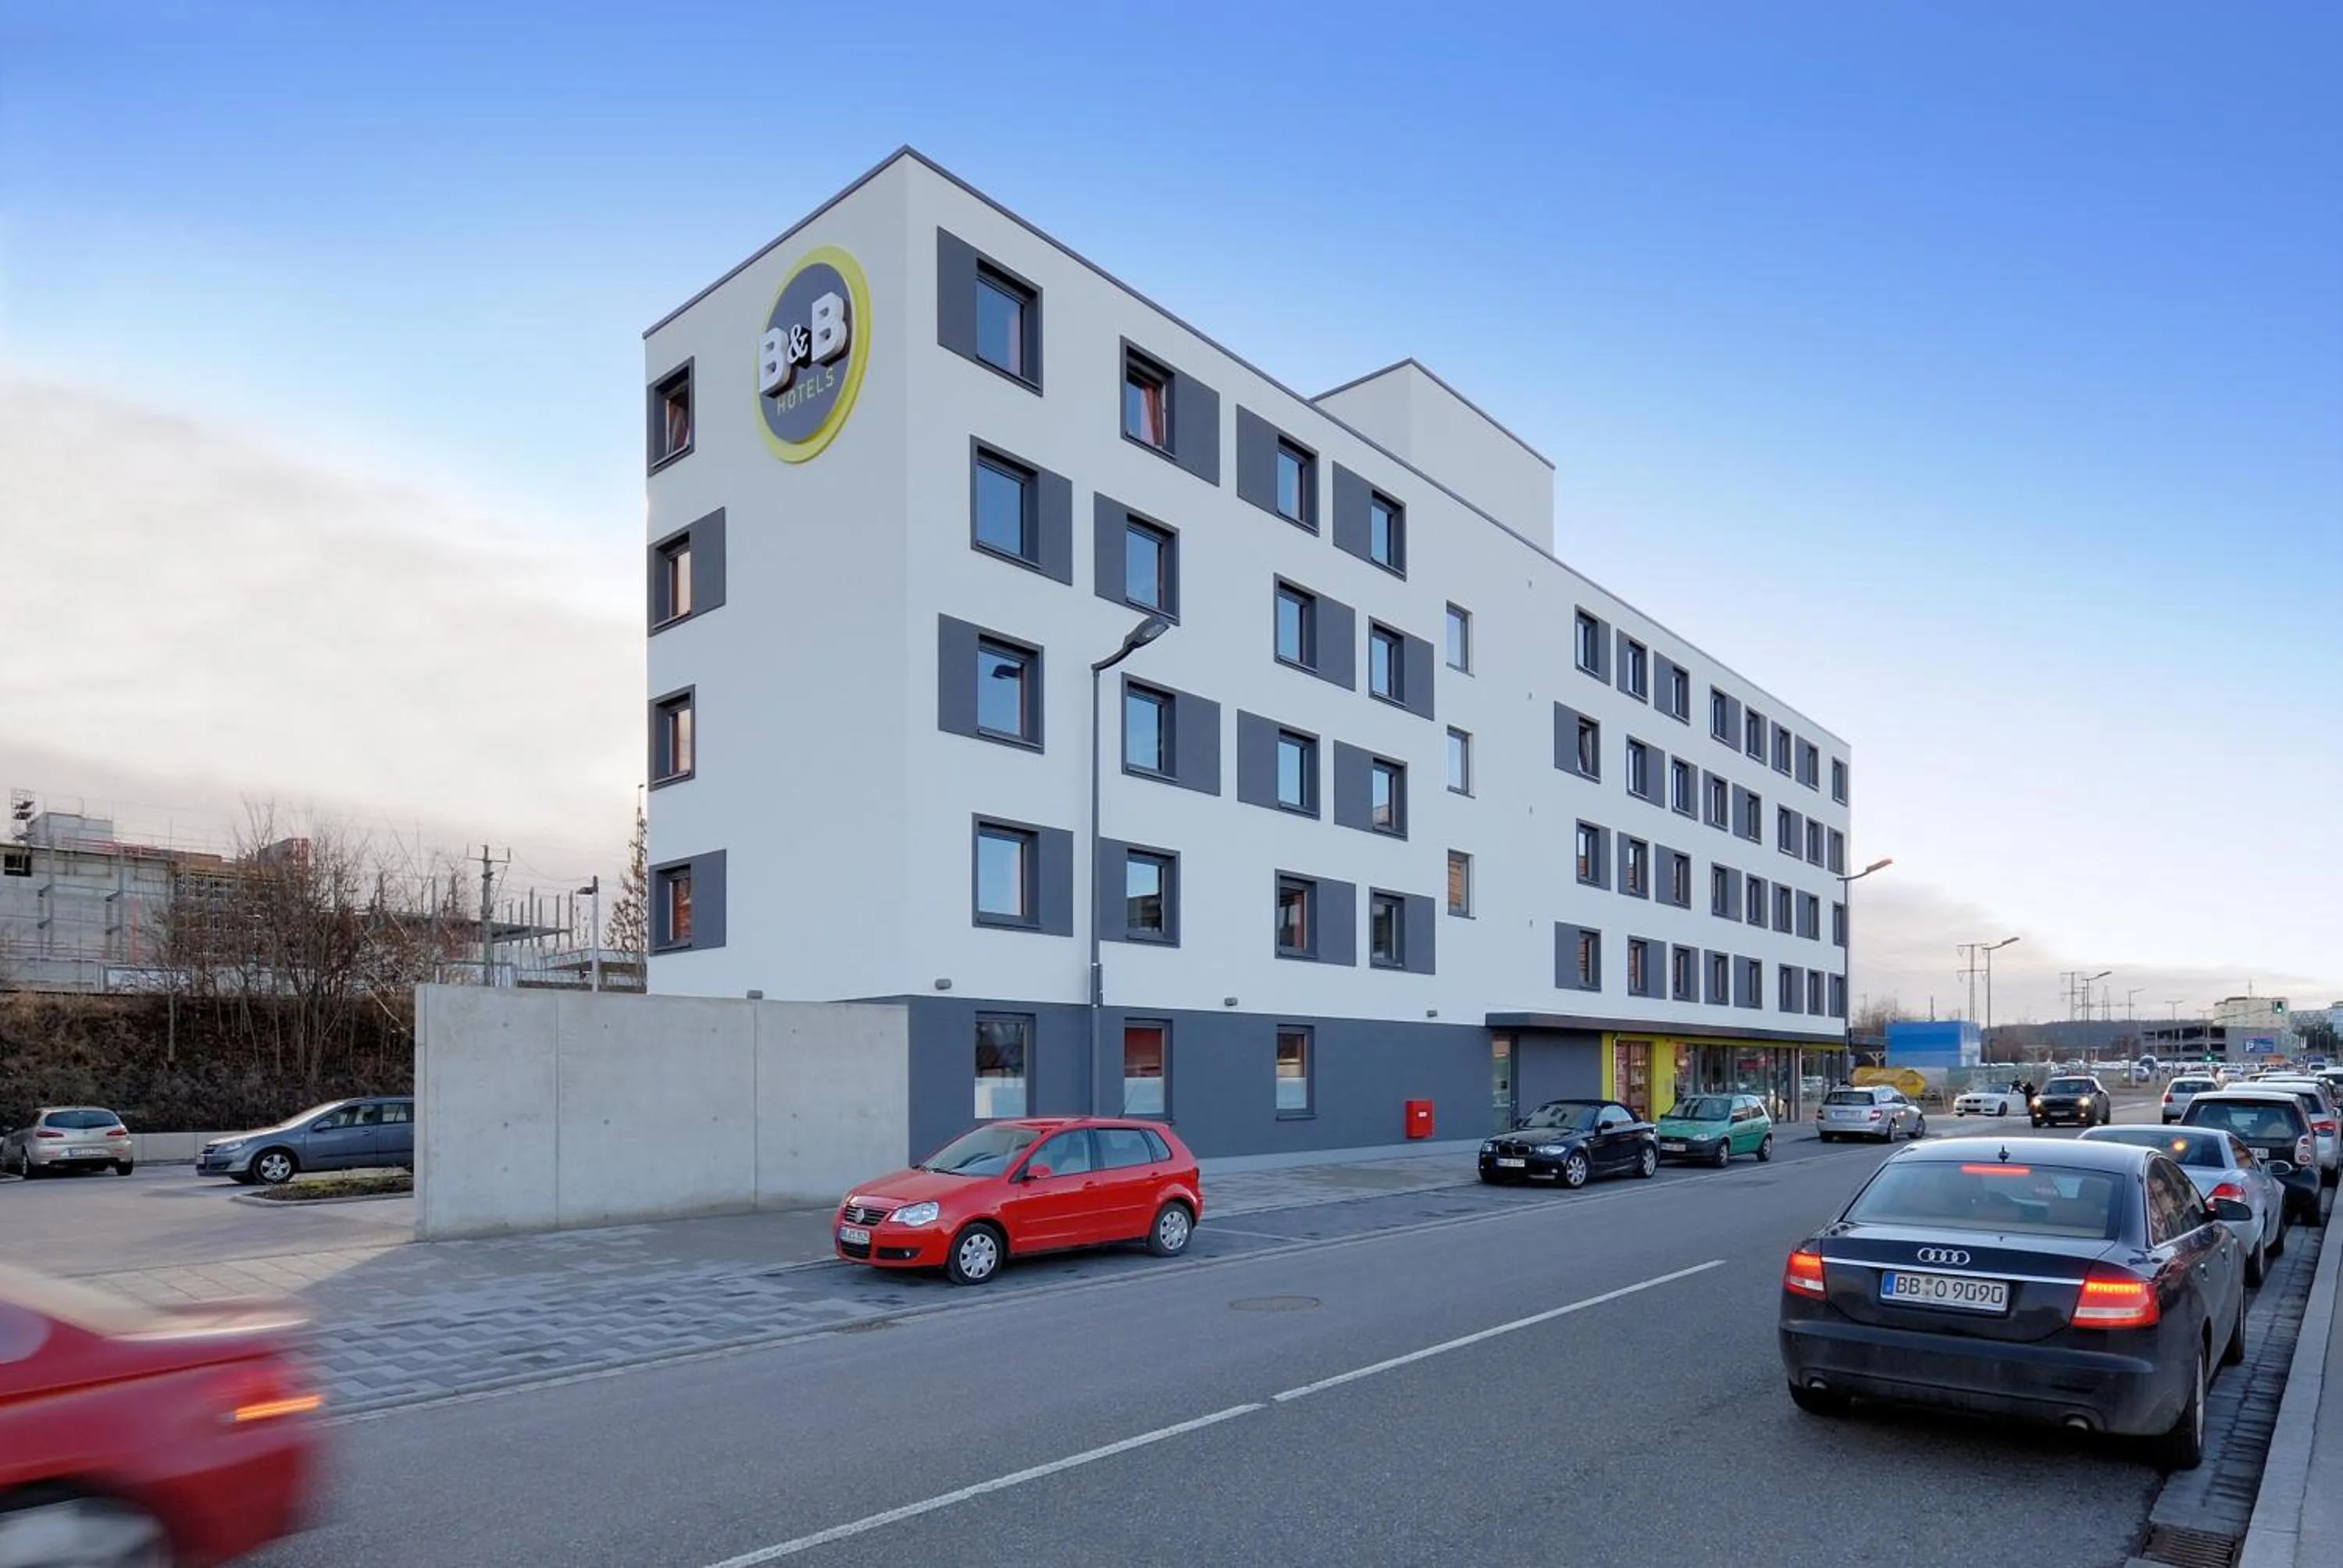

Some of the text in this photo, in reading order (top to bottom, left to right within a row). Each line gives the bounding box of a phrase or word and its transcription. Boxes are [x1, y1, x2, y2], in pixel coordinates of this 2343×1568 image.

[759, 291, 847, 394] B&B
[776, 366, 835, 416] HOTELS
[2245, 1039, 2255, 1053] P
[1895, 1276, 1920, 1295] BB
[1952, 1281, 2004, 1304] 9090
